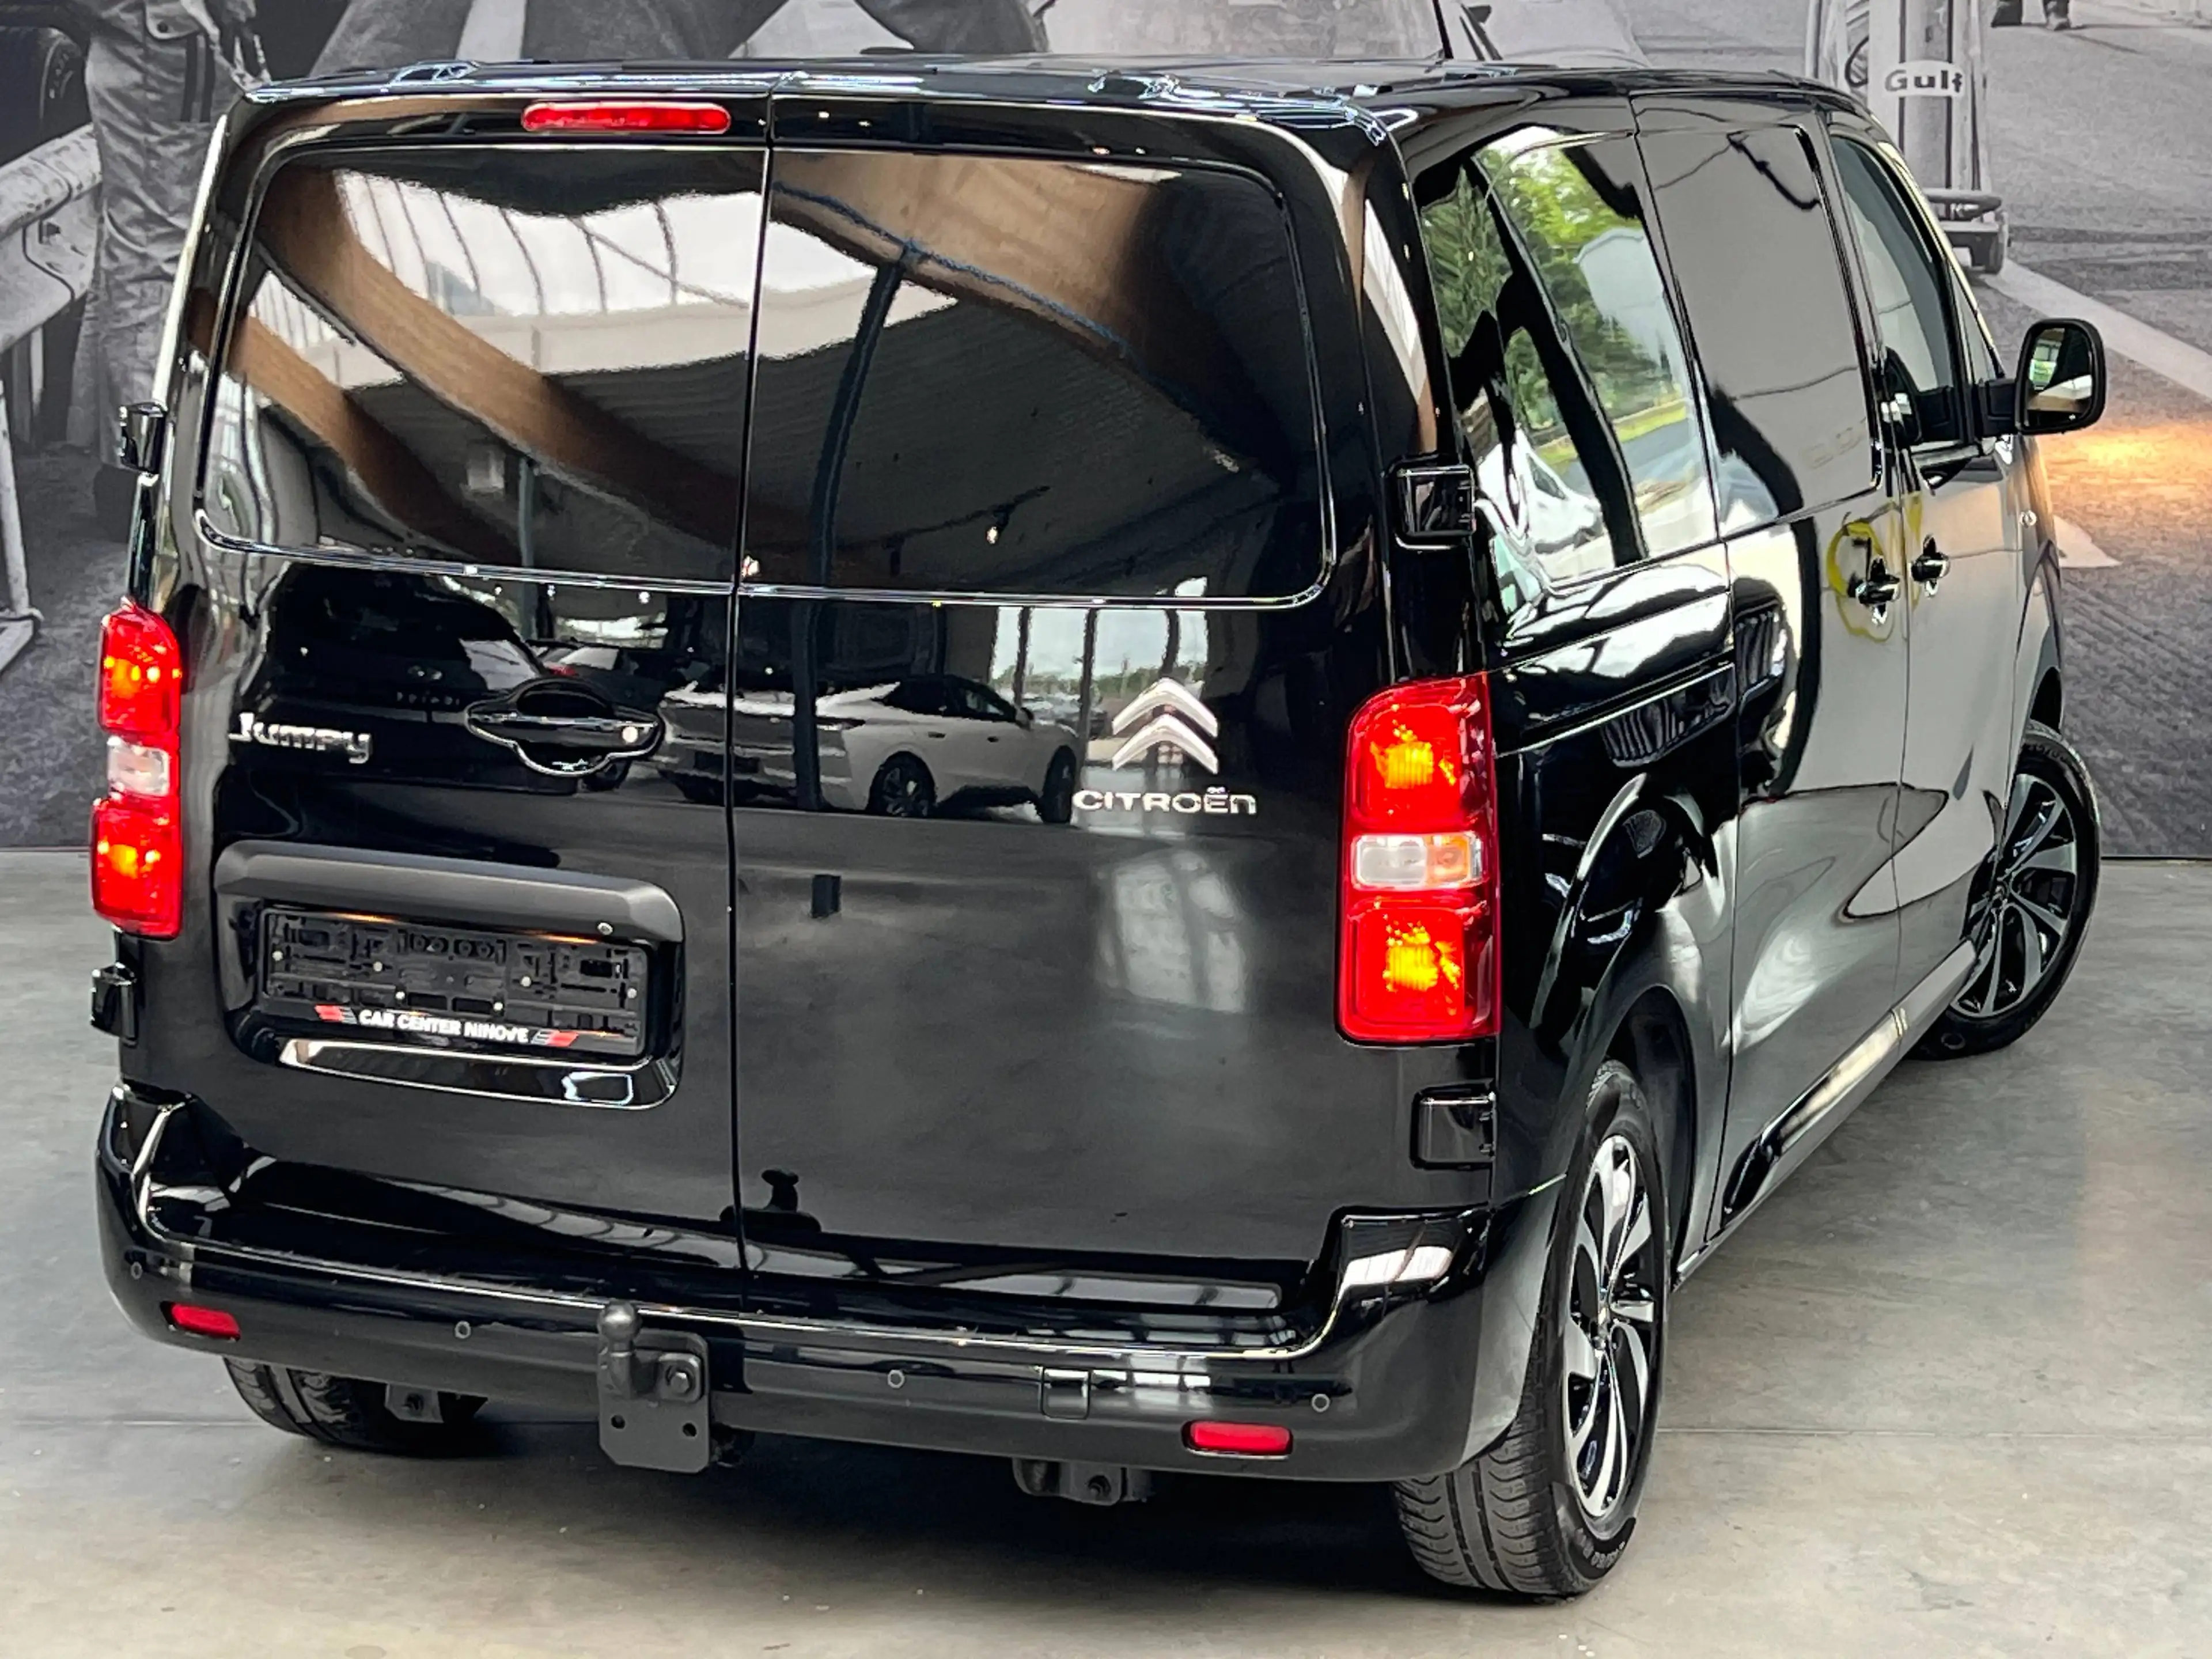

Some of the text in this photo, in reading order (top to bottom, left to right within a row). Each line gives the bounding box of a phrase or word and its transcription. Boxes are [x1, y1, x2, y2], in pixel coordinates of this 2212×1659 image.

[228, 712, 370, 764] Jumpy
[359, 1009, 529, 1043] CAR CENTER NINOVE
